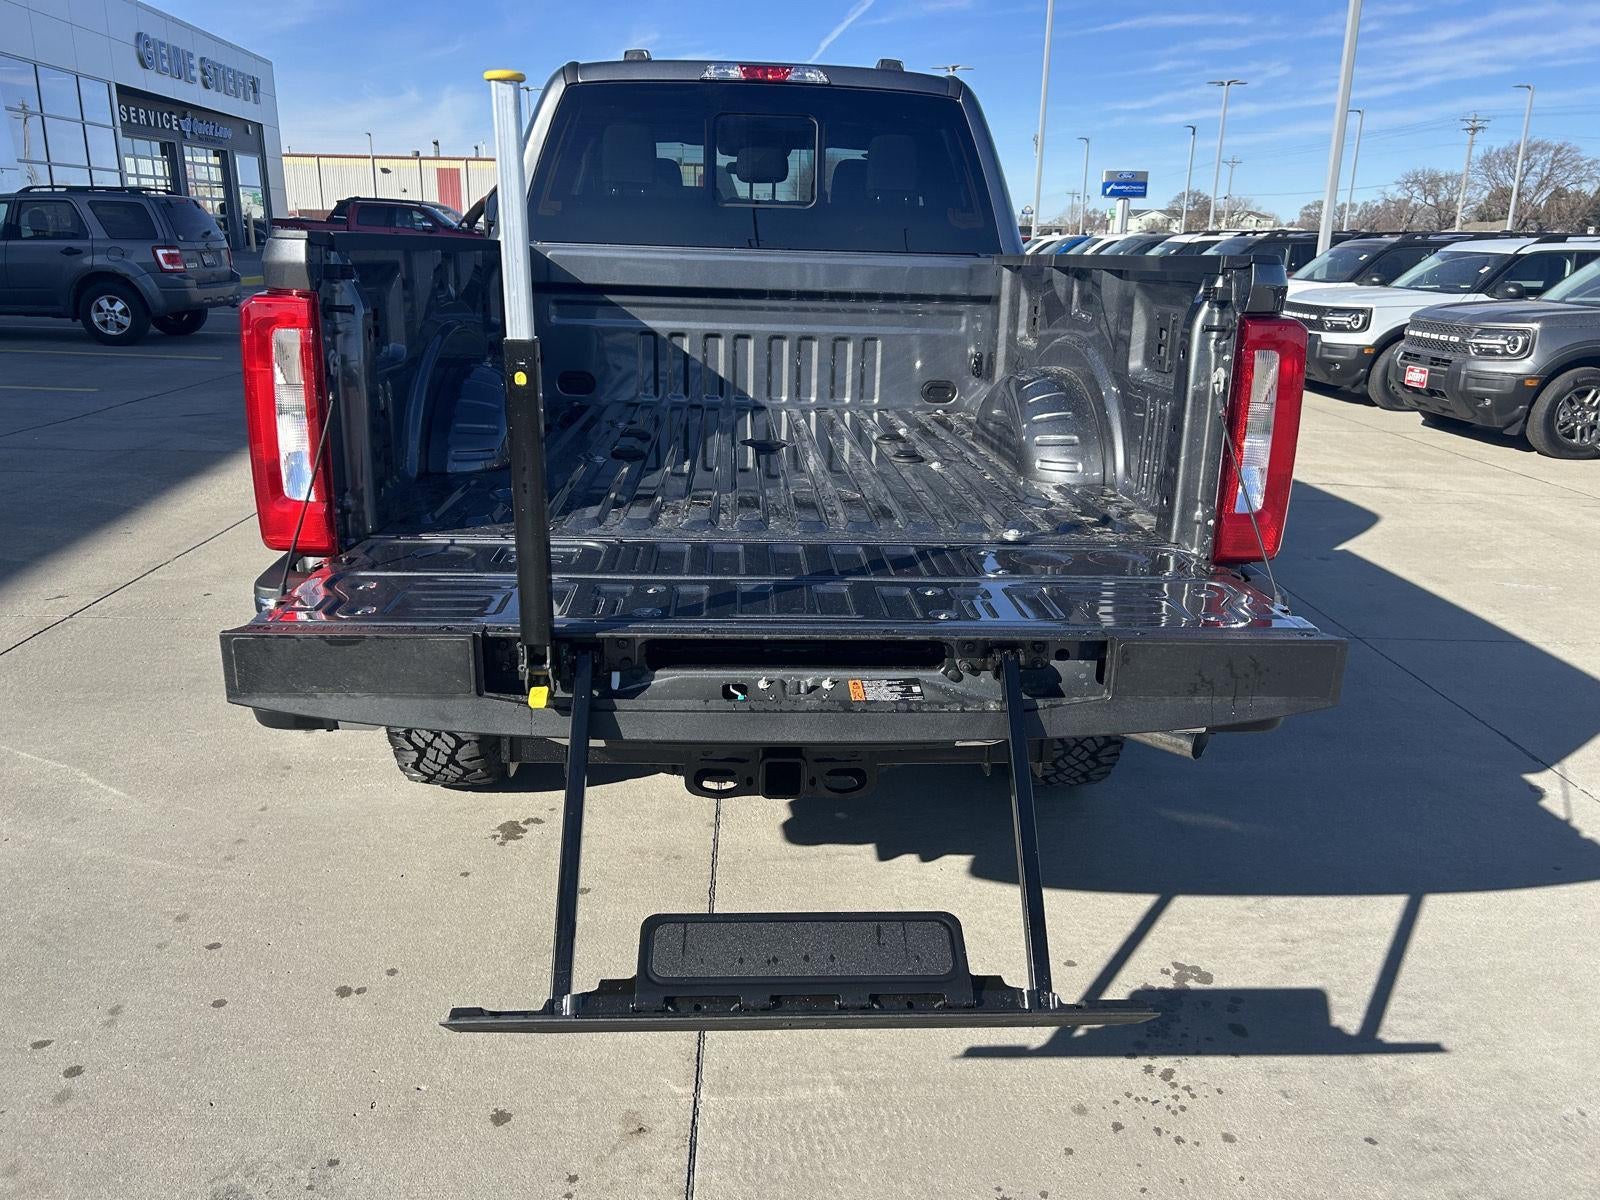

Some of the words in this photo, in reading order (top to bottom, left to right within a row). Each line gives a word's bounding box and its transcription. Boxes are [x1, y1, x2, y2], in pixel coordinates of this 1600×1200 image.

[135, 31, 196, 84] GENE
[199, 56, 262, 105] STEFFY
[120, 104, 179, 131] SERVICE
[1408, 329, 1460, 343] BRONCO
